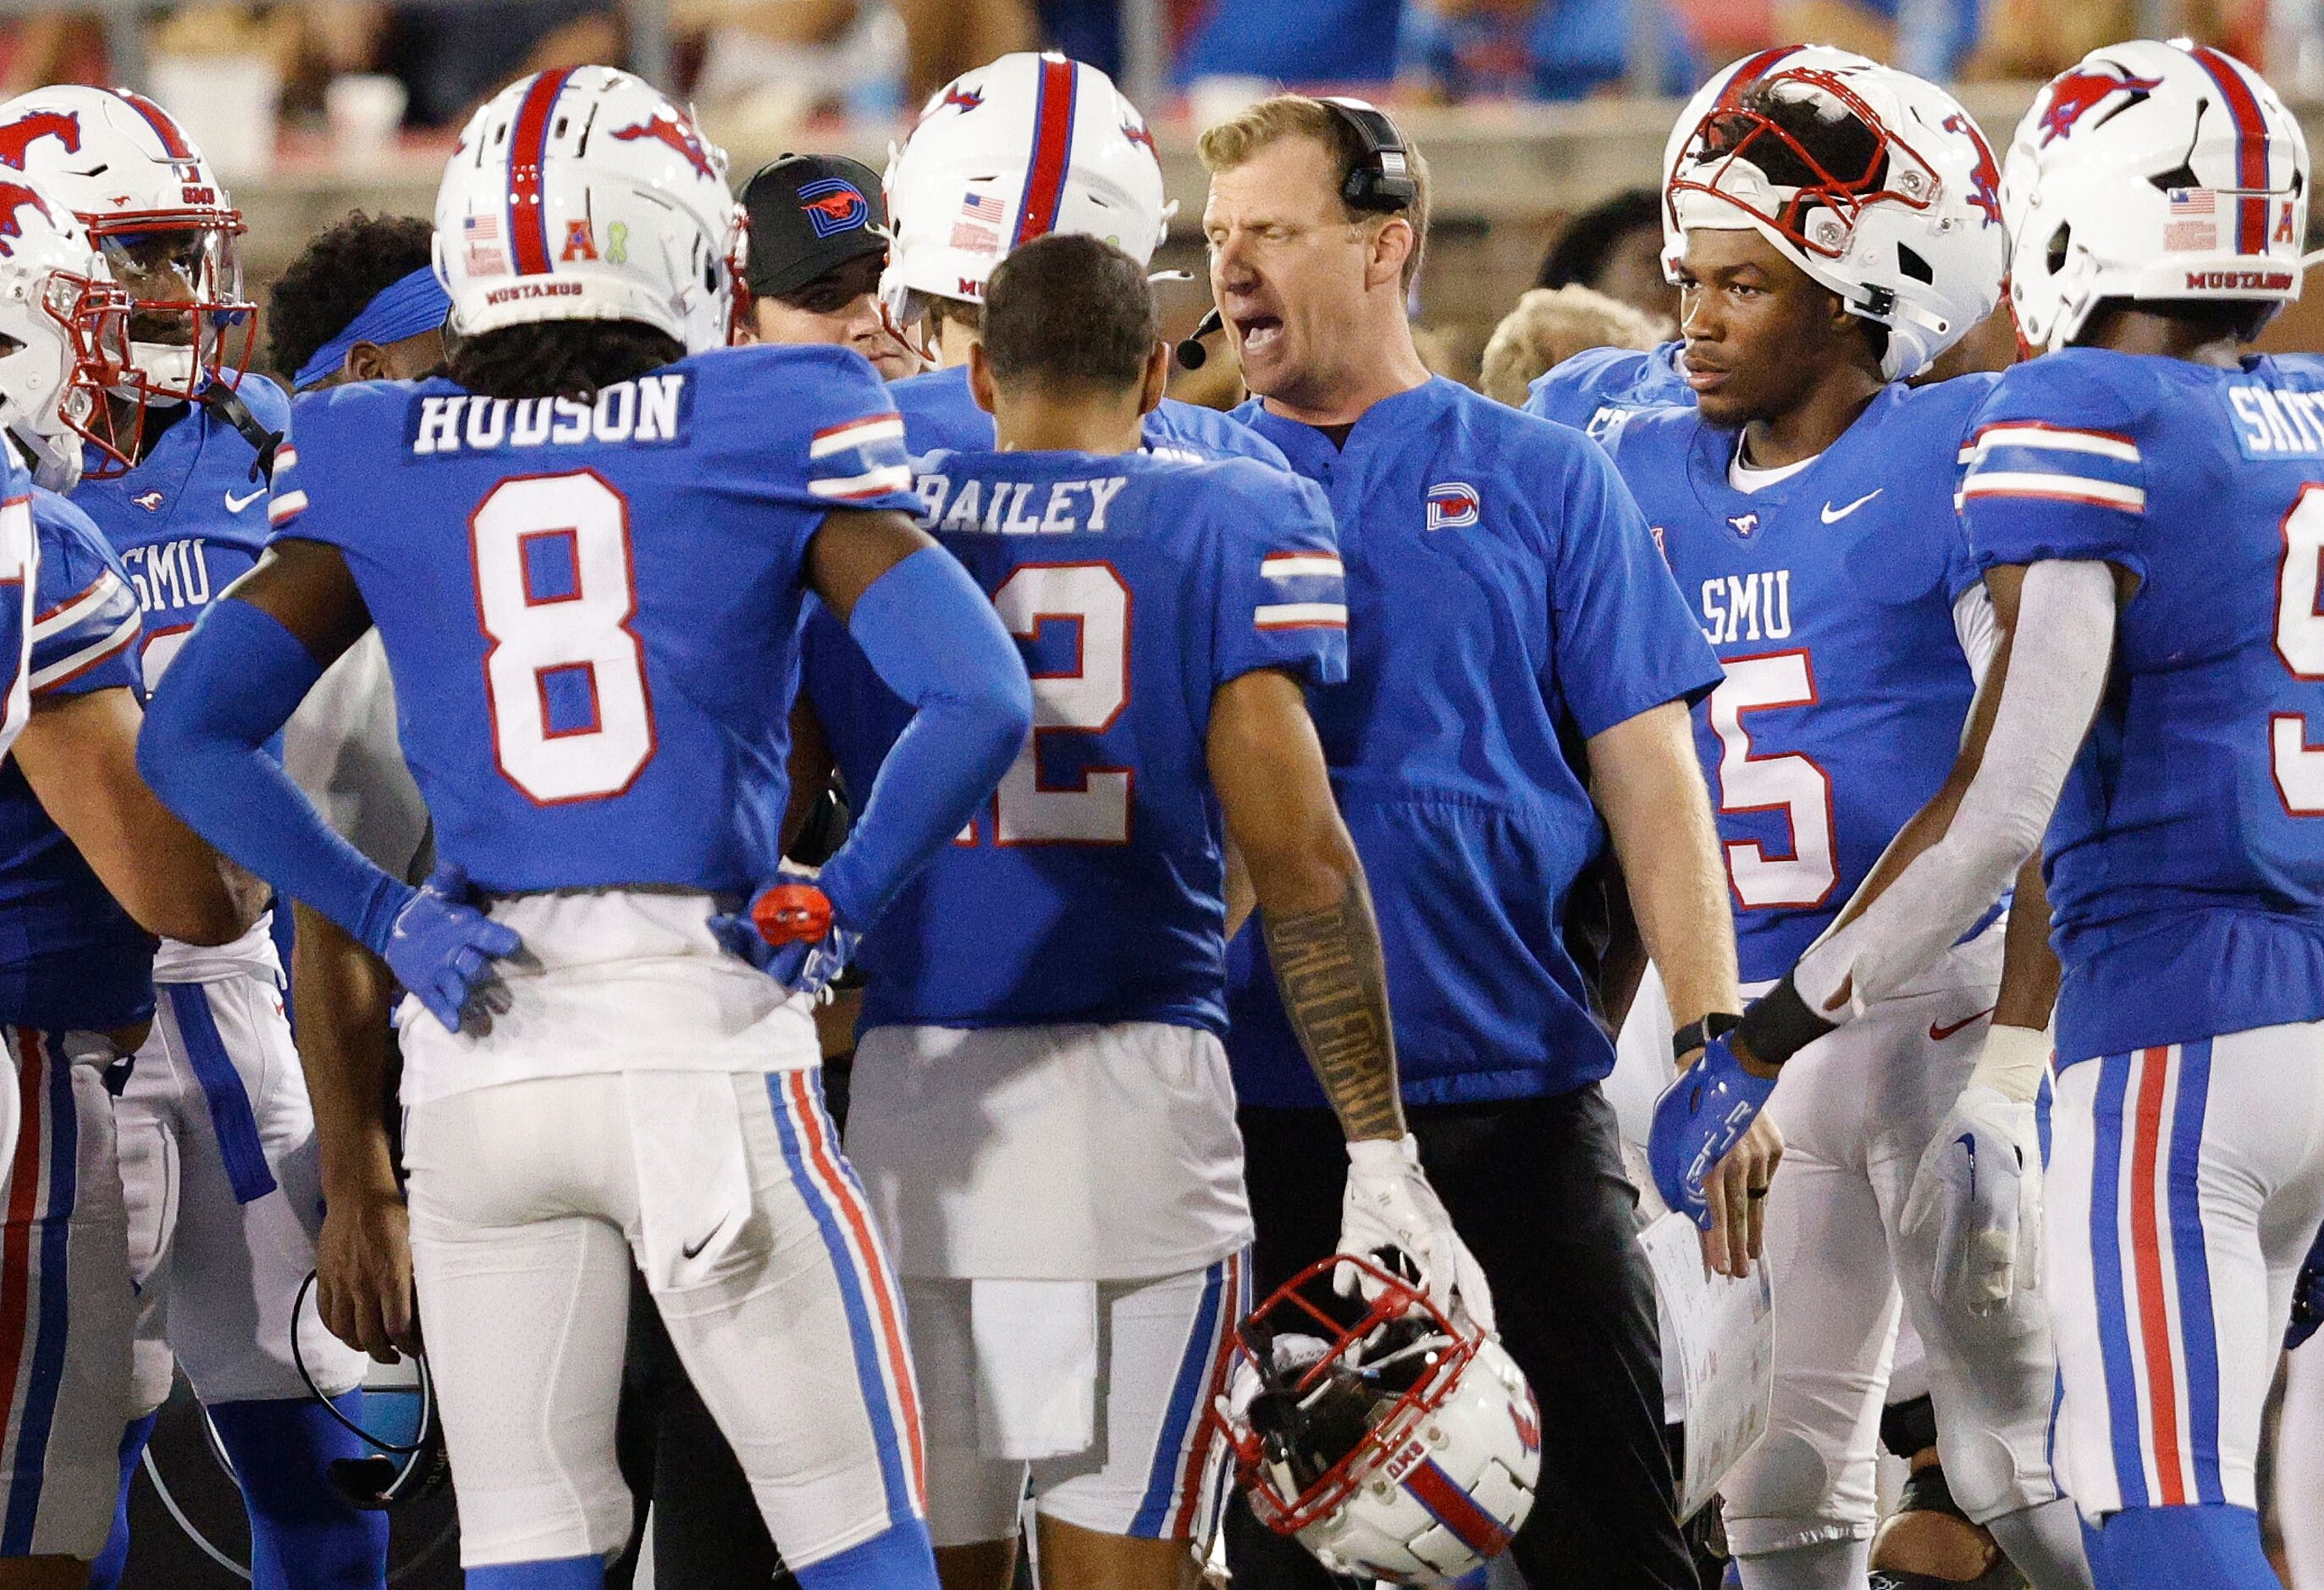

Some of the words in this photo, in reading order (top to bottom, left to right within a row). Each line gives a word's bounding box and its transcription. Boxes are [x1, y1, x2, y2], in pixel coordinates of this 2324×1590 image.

[414, 375, 684, 453] HUDSON
[915, 474, 1129, 534] BAILEY
[120, 538, 210, 612] SMU
[1702, 570, 1791, 645] SMU
[466, 467, 659, 806] 8
[954, 559, 1134, 847] 2
[1707, 647, 1840, 911] 5
